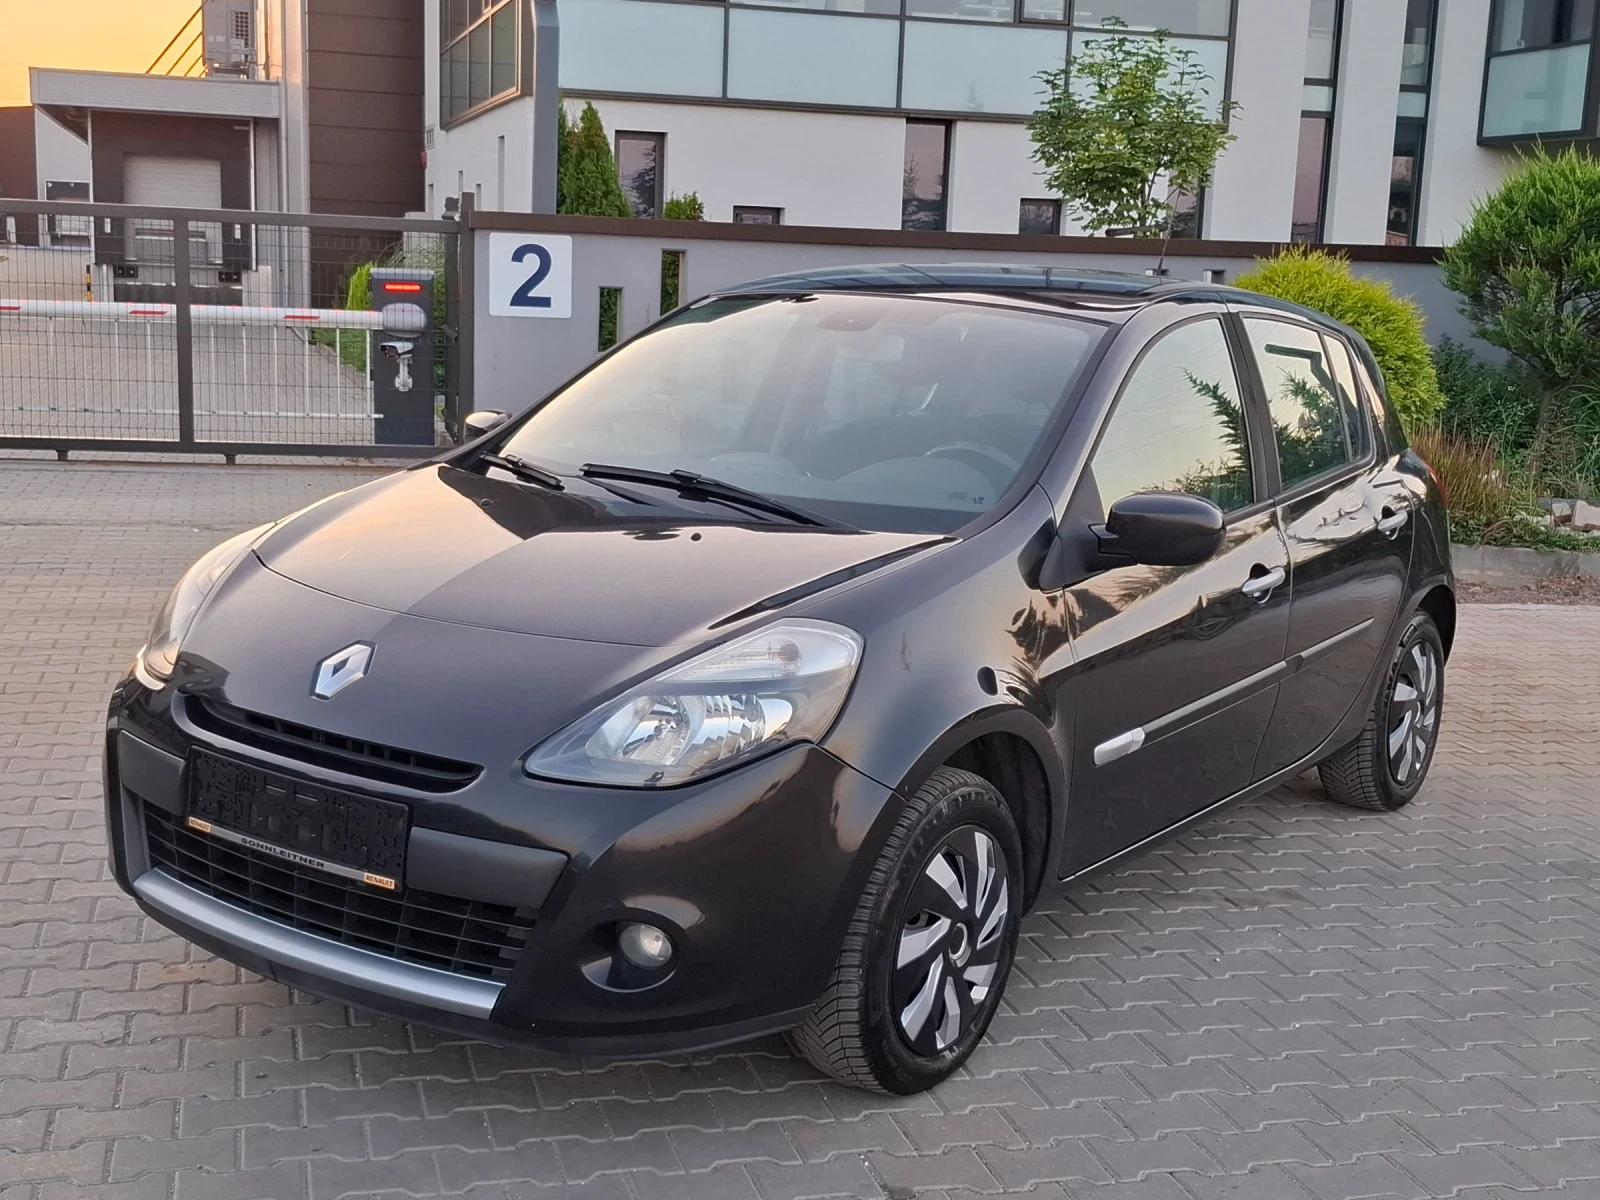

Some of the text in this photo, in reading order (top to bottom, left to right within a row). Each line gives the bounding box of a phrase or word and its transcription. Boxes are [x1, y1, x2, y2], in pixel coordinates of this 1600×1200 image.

[509, 243, 552, 308] 2
[241, 837, 325, 869] SONNLEITNER
[365, 874, 394, 888] RENAULT
